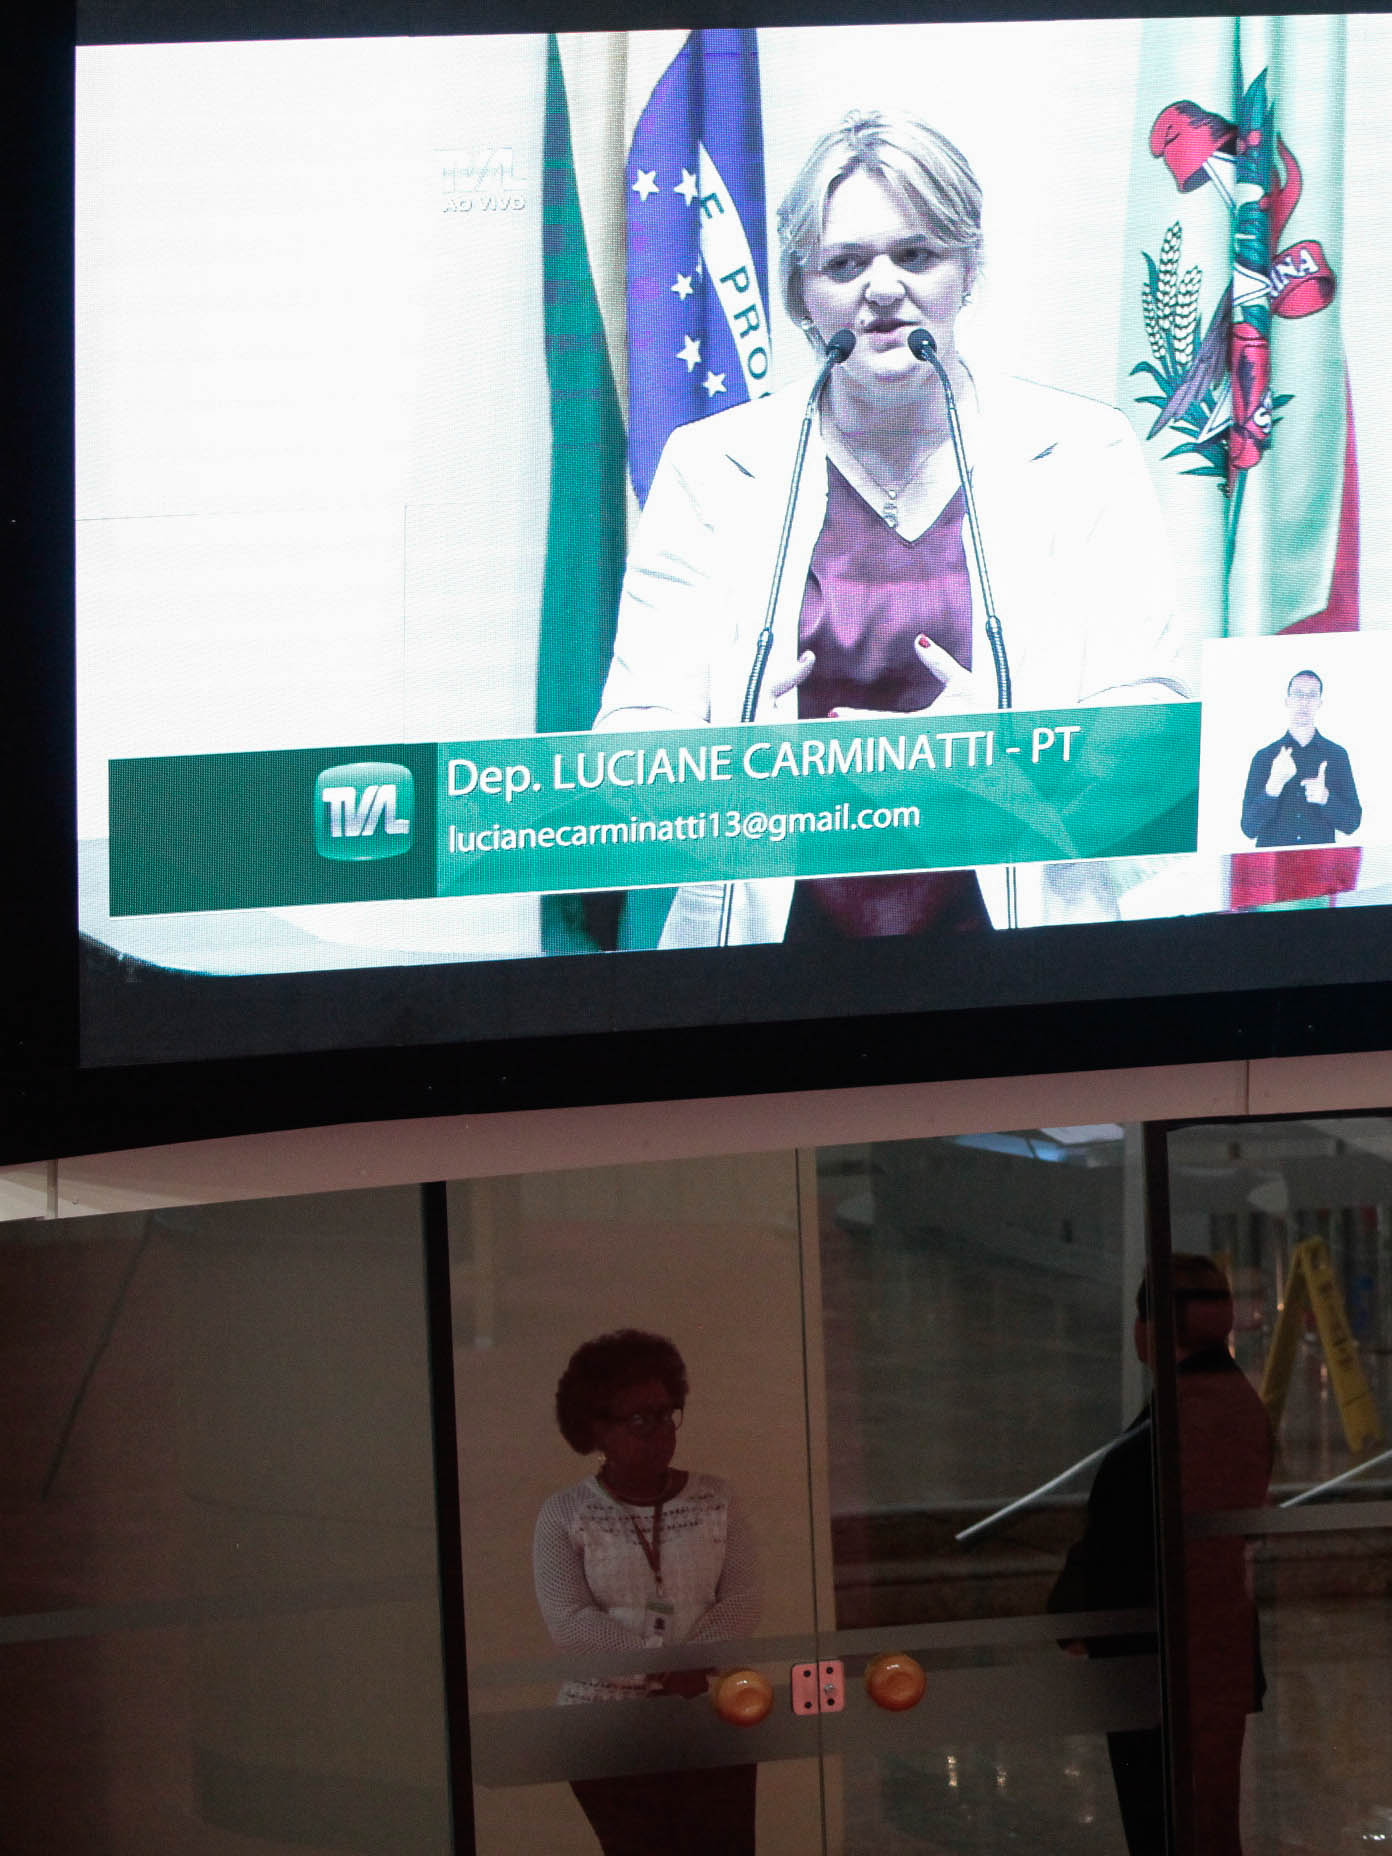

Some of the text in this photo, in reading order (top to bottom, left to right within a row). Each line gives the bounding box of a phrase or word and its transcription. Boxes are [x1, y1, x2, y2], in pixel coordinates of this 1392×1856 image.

[440, 195, 527, 213] AO VIVO
[720, 265, 771, 399] PRO
[448, 758, 542, 803] Dep.
[554, 744, 734, 791] LUCIANE
[743, 730, 995, 780] CARMINATTI
[1032, 726, 1082, 763] PT
[449, 803, 921, 853] lucianecarminatti13@gmail.com
